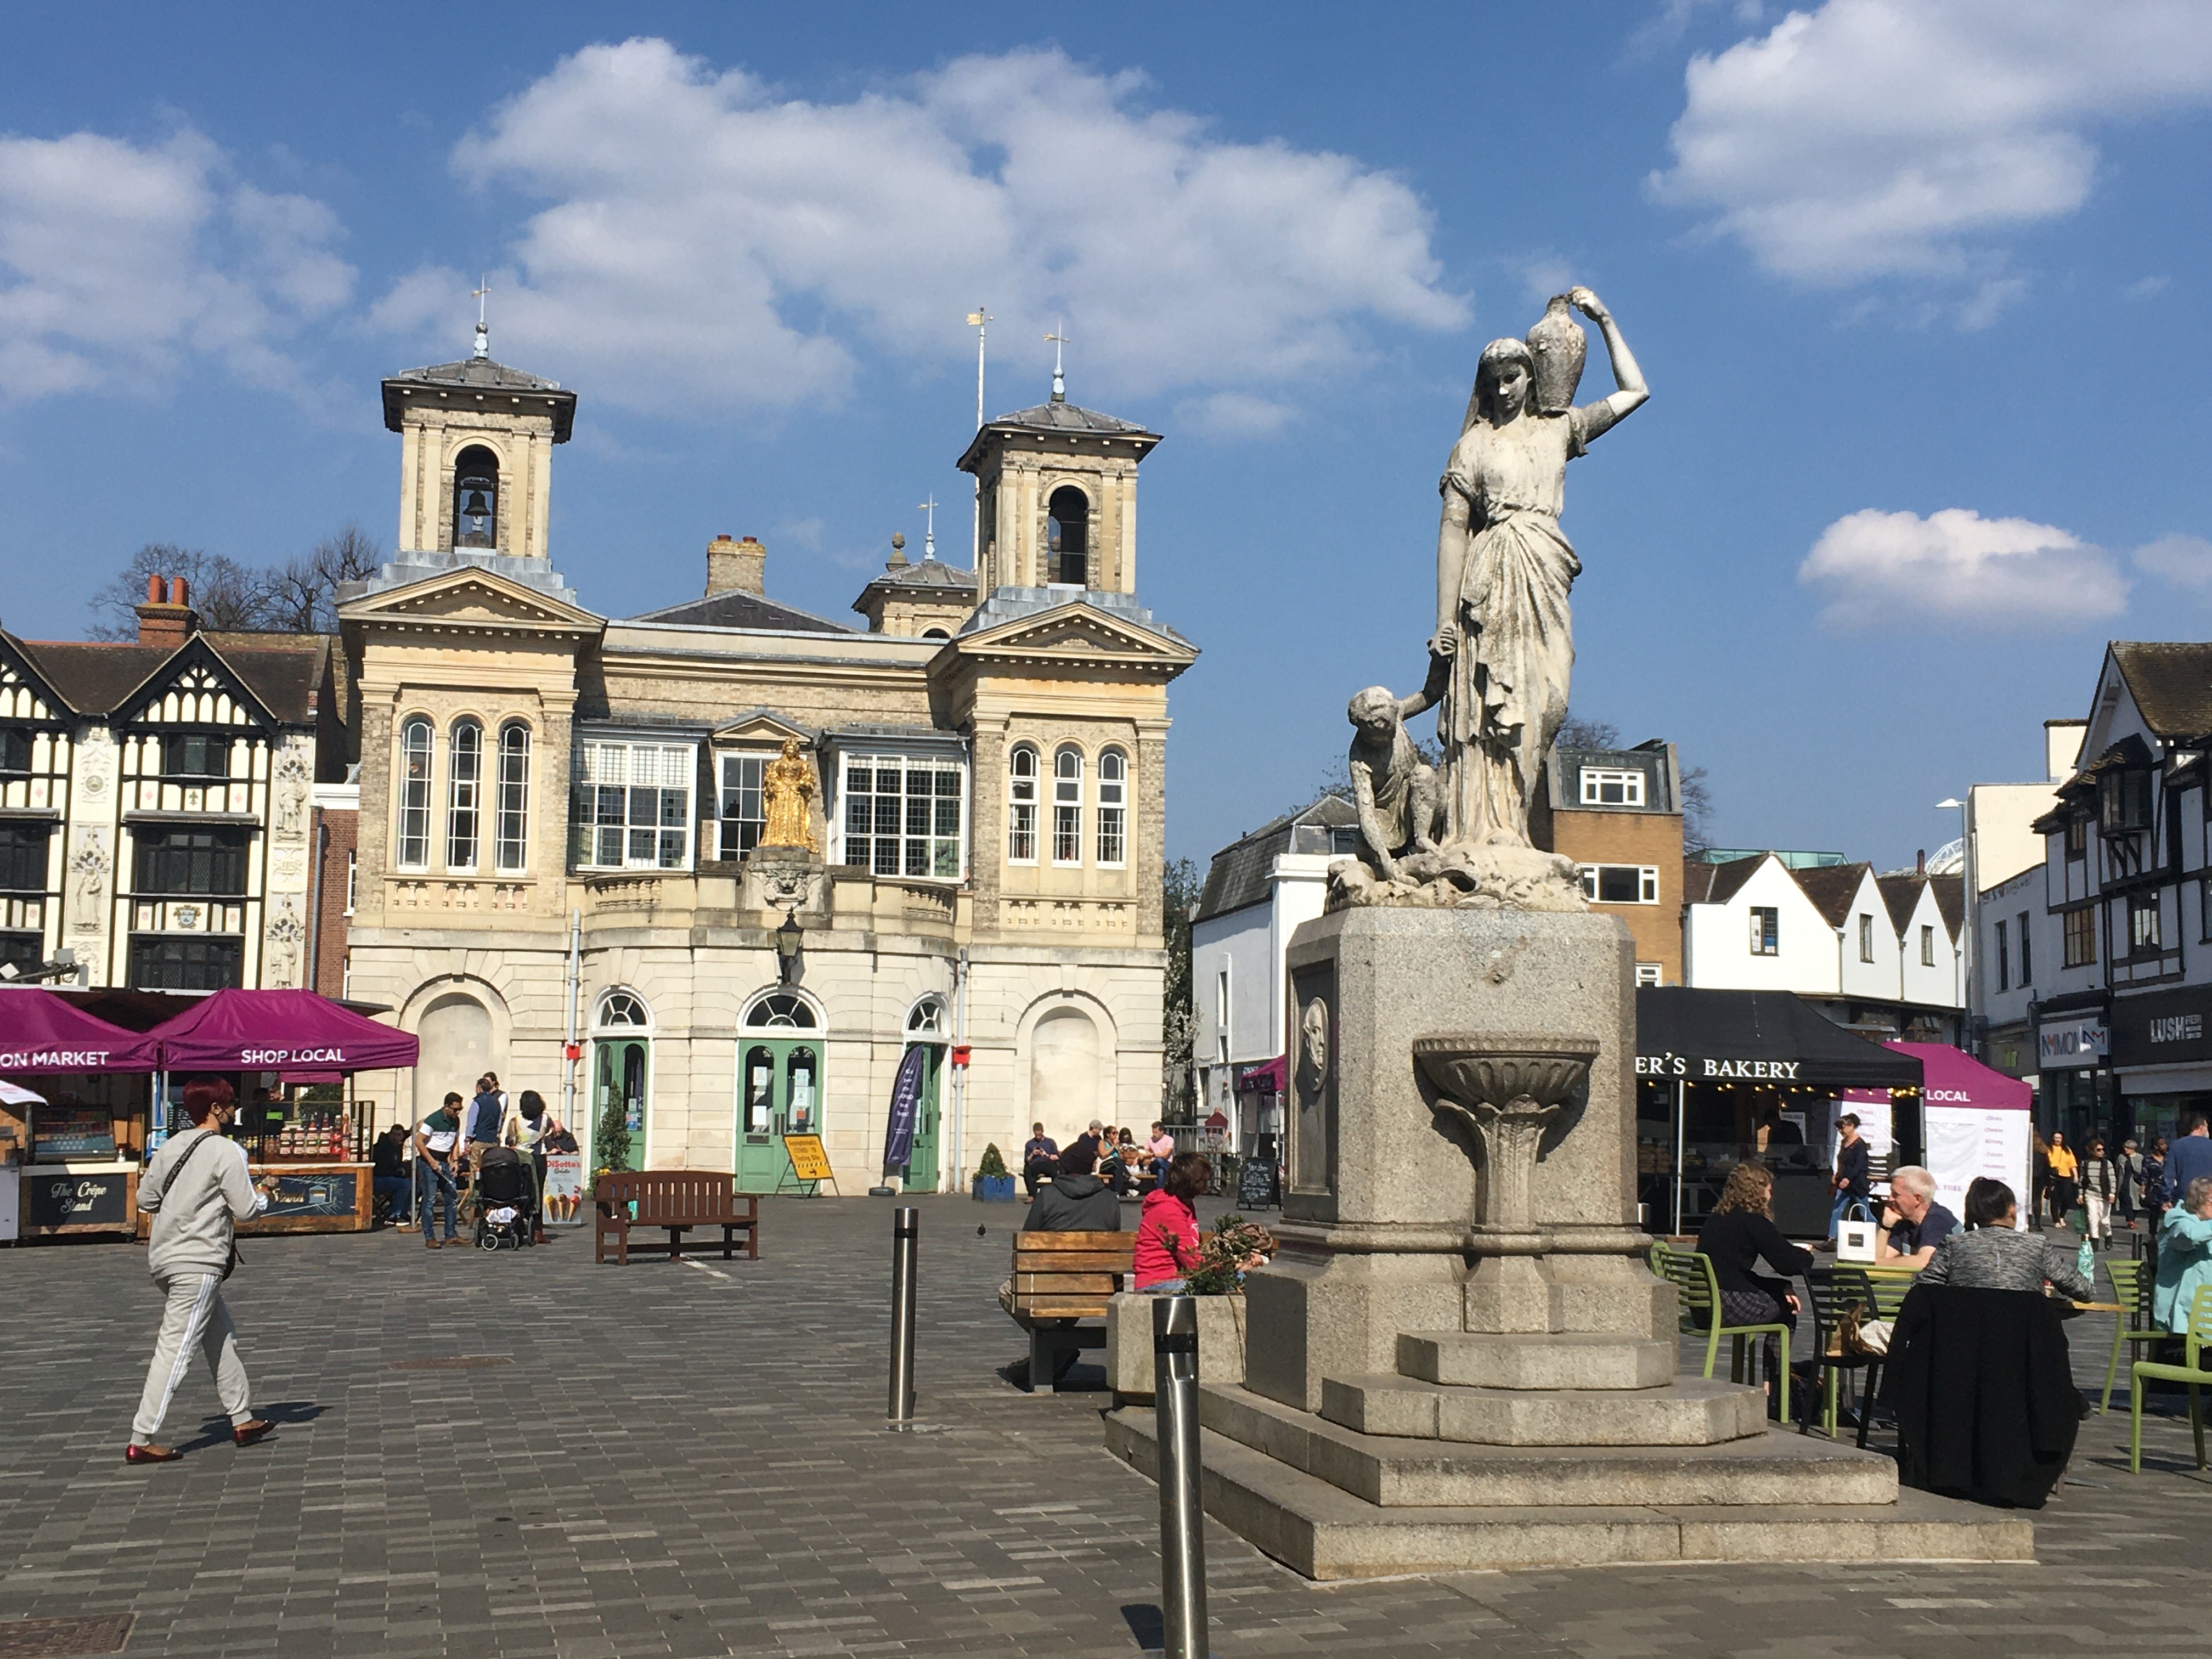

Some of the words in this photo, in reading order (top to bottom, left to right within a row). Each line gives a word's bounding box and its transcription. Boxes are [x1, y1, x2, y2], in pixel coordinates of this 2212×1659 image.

[2151, 1017, 2185, 1043] LUSH
[0, 1052, 27, 1068] ON
[32, 1051, 109, 1066] MARKET
[241, 1049, 288, 1063] SHOP
[291, 1048, 346, 1062] LOCAL
[1703, 1059, 1799, 1079] BAKERY
[1927, 1089, 1971, 1103] LOCAL
[51, 1183, 72, 1198] The
[77, 1181, 106, 1198] Crêpe
[60, 1198, 94, 1214] Stand
